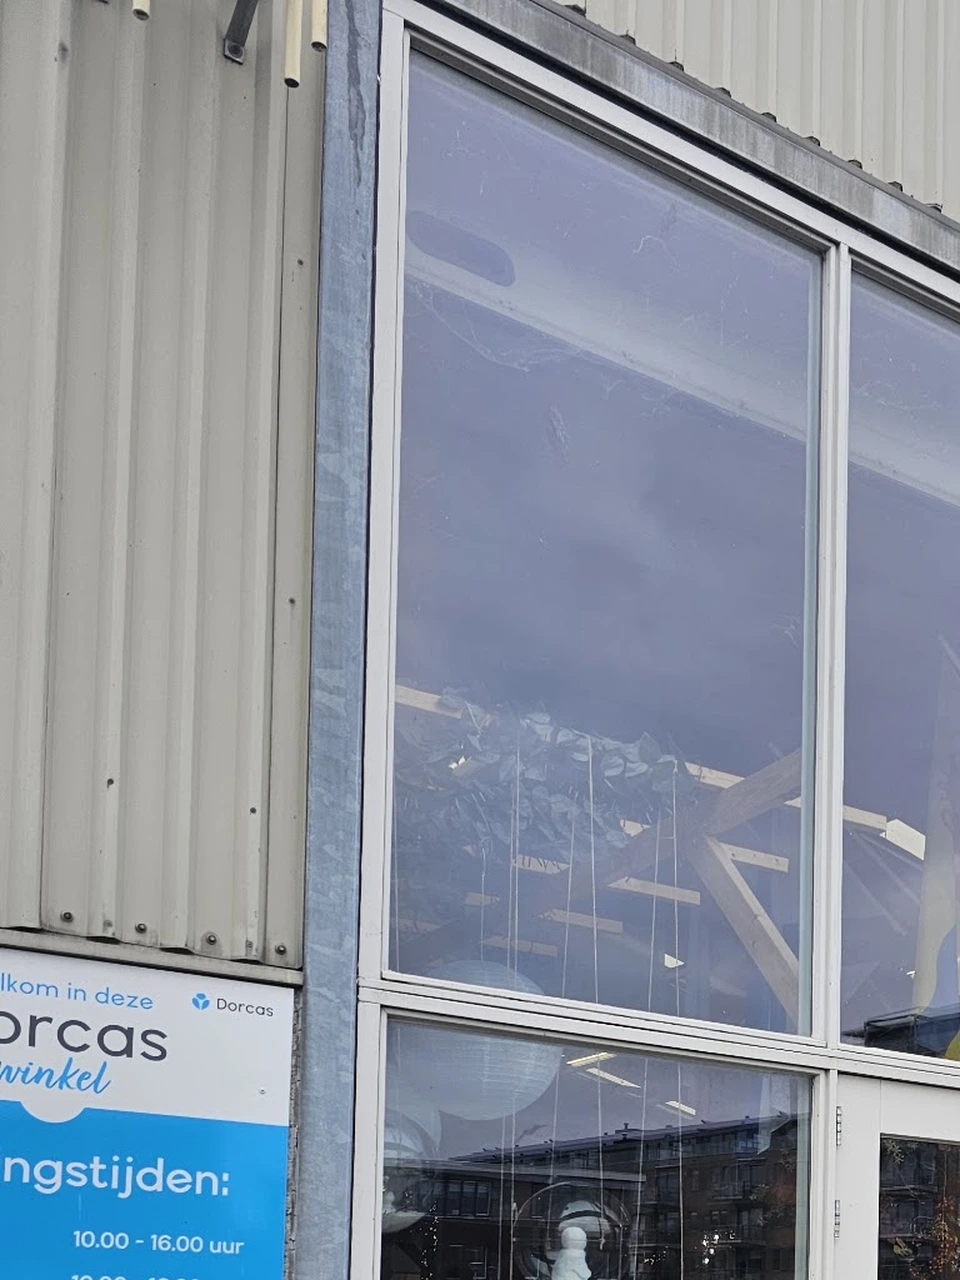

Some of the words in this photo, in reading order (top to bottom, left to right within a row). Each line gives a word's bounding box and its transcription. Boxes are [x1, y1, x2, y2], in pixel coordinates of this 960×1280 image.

[67, 982, 87, 1001] in
[94, 987, 154, 1010] deze
[216, 998, 274, 1017] Dorcas
[3, 1155, 230, 1199] ngstijden:
[73, 1230, 130, 1250] 10.00
[150, 1234, 204, 1253] 16.00
[209, 1240, 245, 1255] uur
